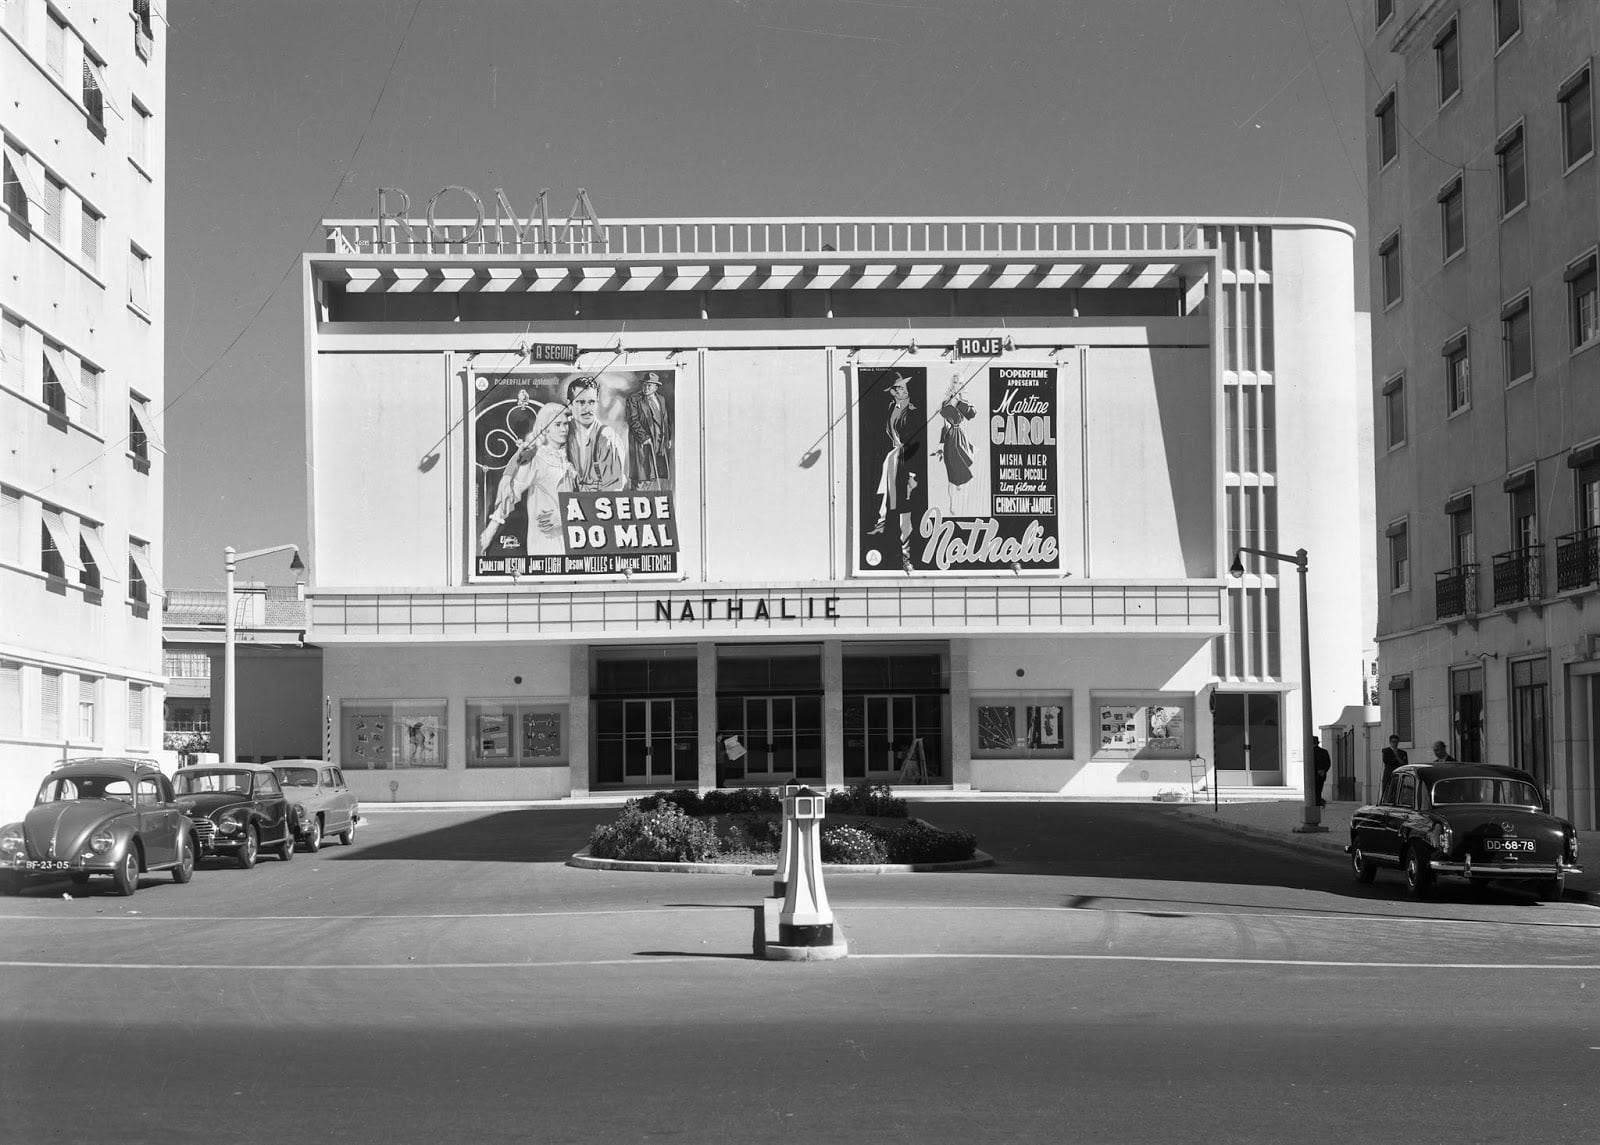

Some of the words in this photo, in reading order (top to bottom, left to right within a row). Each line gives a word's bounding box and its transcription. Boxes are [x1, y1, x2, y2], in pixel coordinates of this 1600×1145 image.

[377, 185, 608, 244] ROMA
[536, 345, 543, 360] A
[545, 345, 574, 361] SEGUIR
[961, 339, 1000, 354] HOJE
[1000, 369, 1048, 378] DOPERFILME
[1008, 379, 1039, 387] APRESENTA
[993, 388, 1049, 415] Martine
[990, 415, 1056, 446] CAROL
[1000, 454, 1023, 466] MISHA
[1027, 454, 1047, 466] AUER
[1000, 468, 1022, 480] MICHEL
[1024, 468, 1047, 480] PICCOLI
[1000, 482, 1014, 492] Um
[1014, 482, 1036, 495] filme
[1037, 482, 1047, 492] de
[567, 497, 586, 521] A
[594, 496, 670, 520] SEDE
[567, 525, 607, 549] DO
[614, 524, 673, 548] MAL
[919, 507, 1059, 570] Nathalie
[545, 556, 562, 573] LEIGH
[584, 556, 608, 573] WELLES
[641, 554, 672, 572] DIETRICH
[656, 597, 840, 621] NATHALIE
[1487, 840, 1534, 850] DD-68-78
[26, 860, 70, 869] BF-23-05
